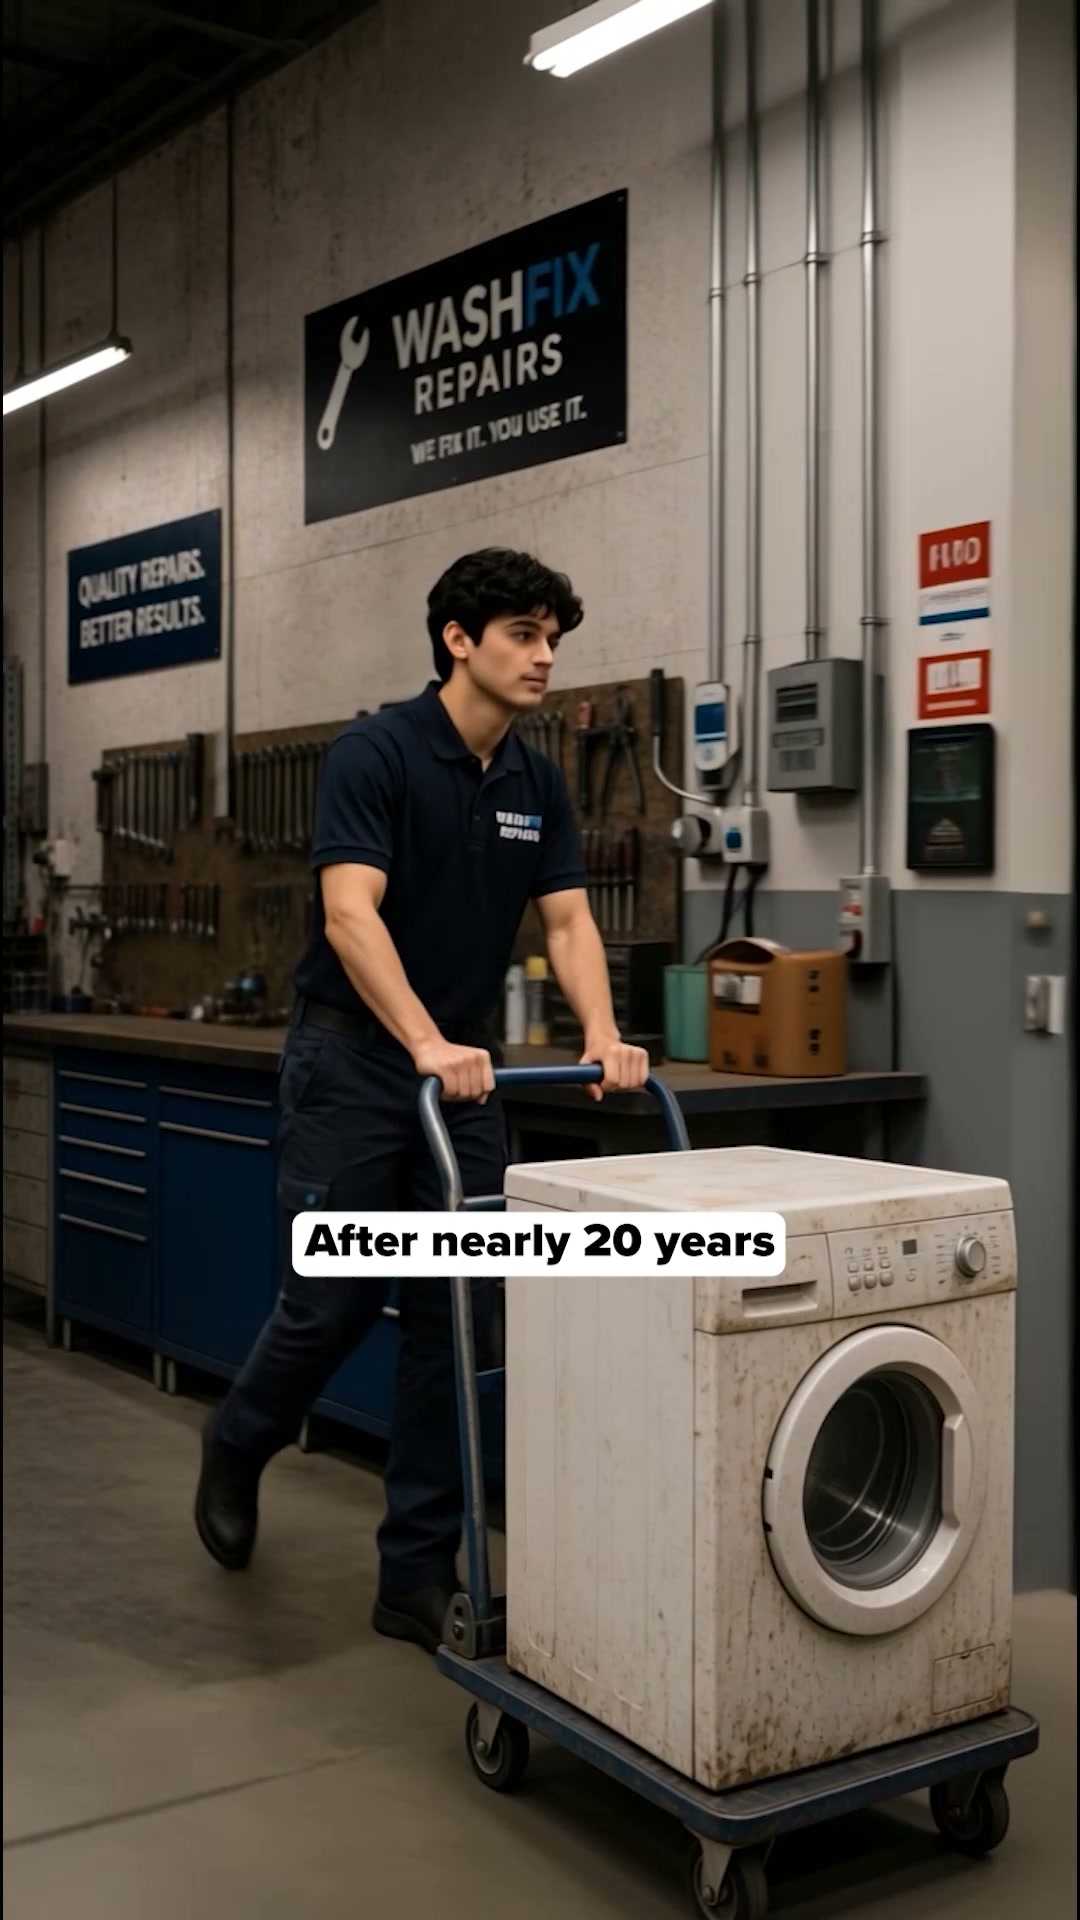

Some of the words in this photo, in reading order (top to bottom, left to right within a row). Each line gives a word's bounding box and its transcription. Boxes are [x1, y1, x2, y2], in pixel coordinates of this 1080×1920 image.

[392, 243, 600, 369] WASHFIX
[415, 333, 563, 415] REPAIRS
[410, 438, 435, 464] WE
[466, 425, 487, 450] IT.
[488, 413, 522, 443] YOU
[526, 402, 561, 433] USE
[565, 394, 587, 423] IT.
[79, 564, 138, 608] QUALITY
[140, 549, 205, 593] REPAIRS.
[80, 610, 133, 649] BETTER
[136, 595, 205, 637] RESULTS.
